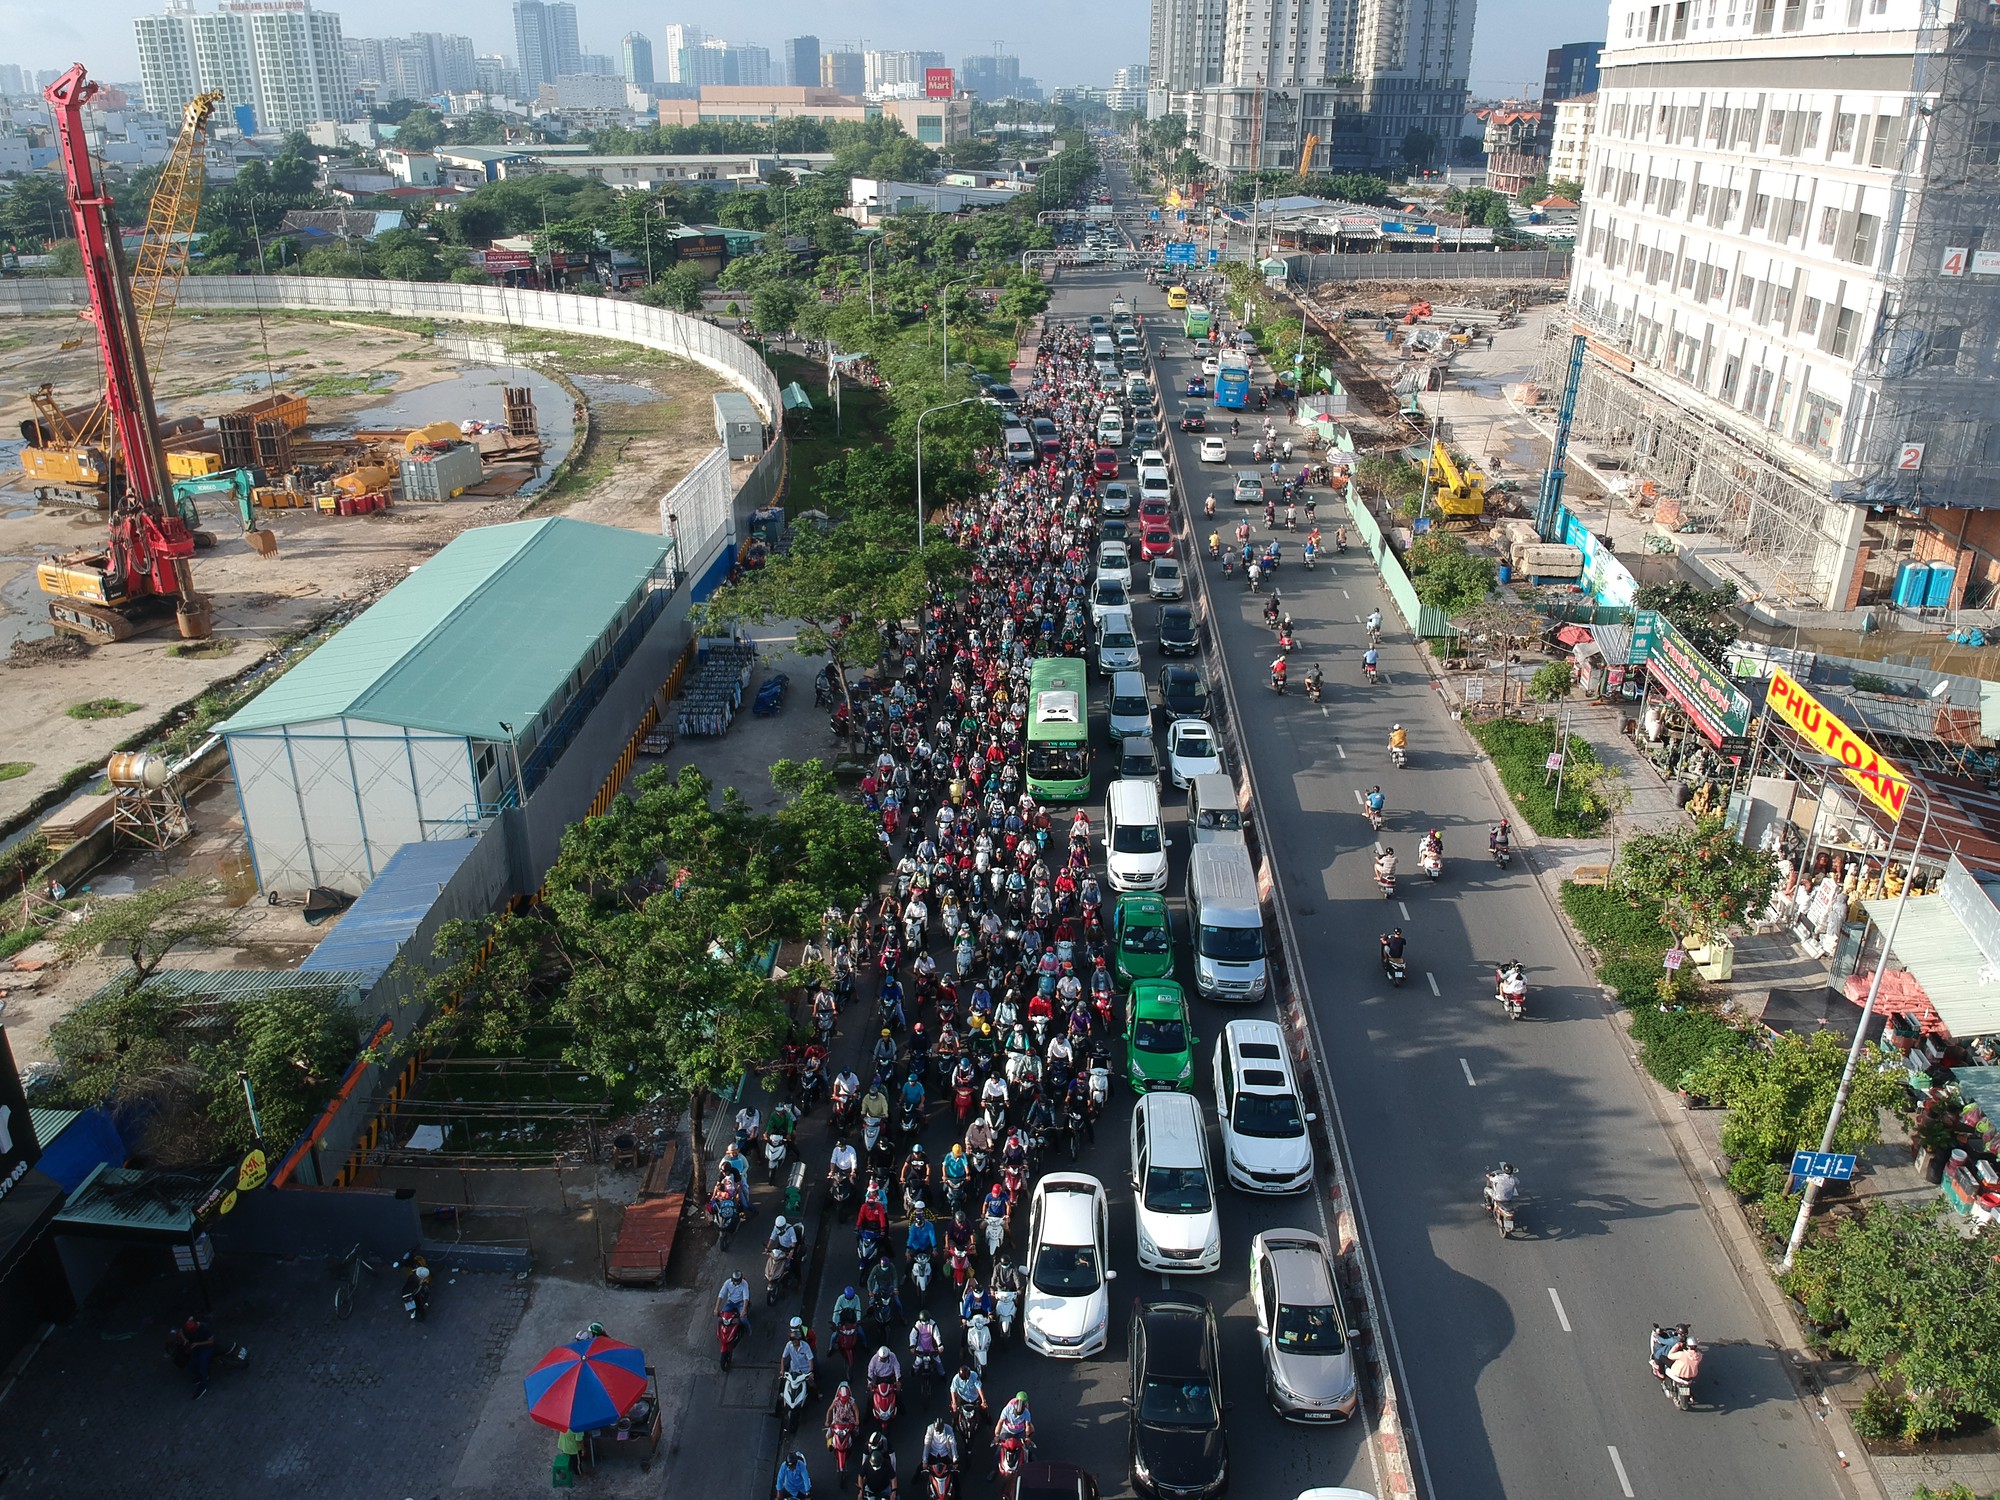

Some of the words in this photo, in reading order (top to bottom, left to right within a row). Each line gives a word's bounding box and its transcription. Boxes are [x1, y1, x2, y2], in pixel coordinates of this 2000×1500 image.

[928, 81, 950, 90] Mart
[1402, 224, 1418, 234] Tiger
[1943, 253, 1962, 275] 4
[1900, 448, 1920, 469] 2
[1770, 675, 1822, 734] PHÚ
[1824, 719, 1906, 813] TOÀN
